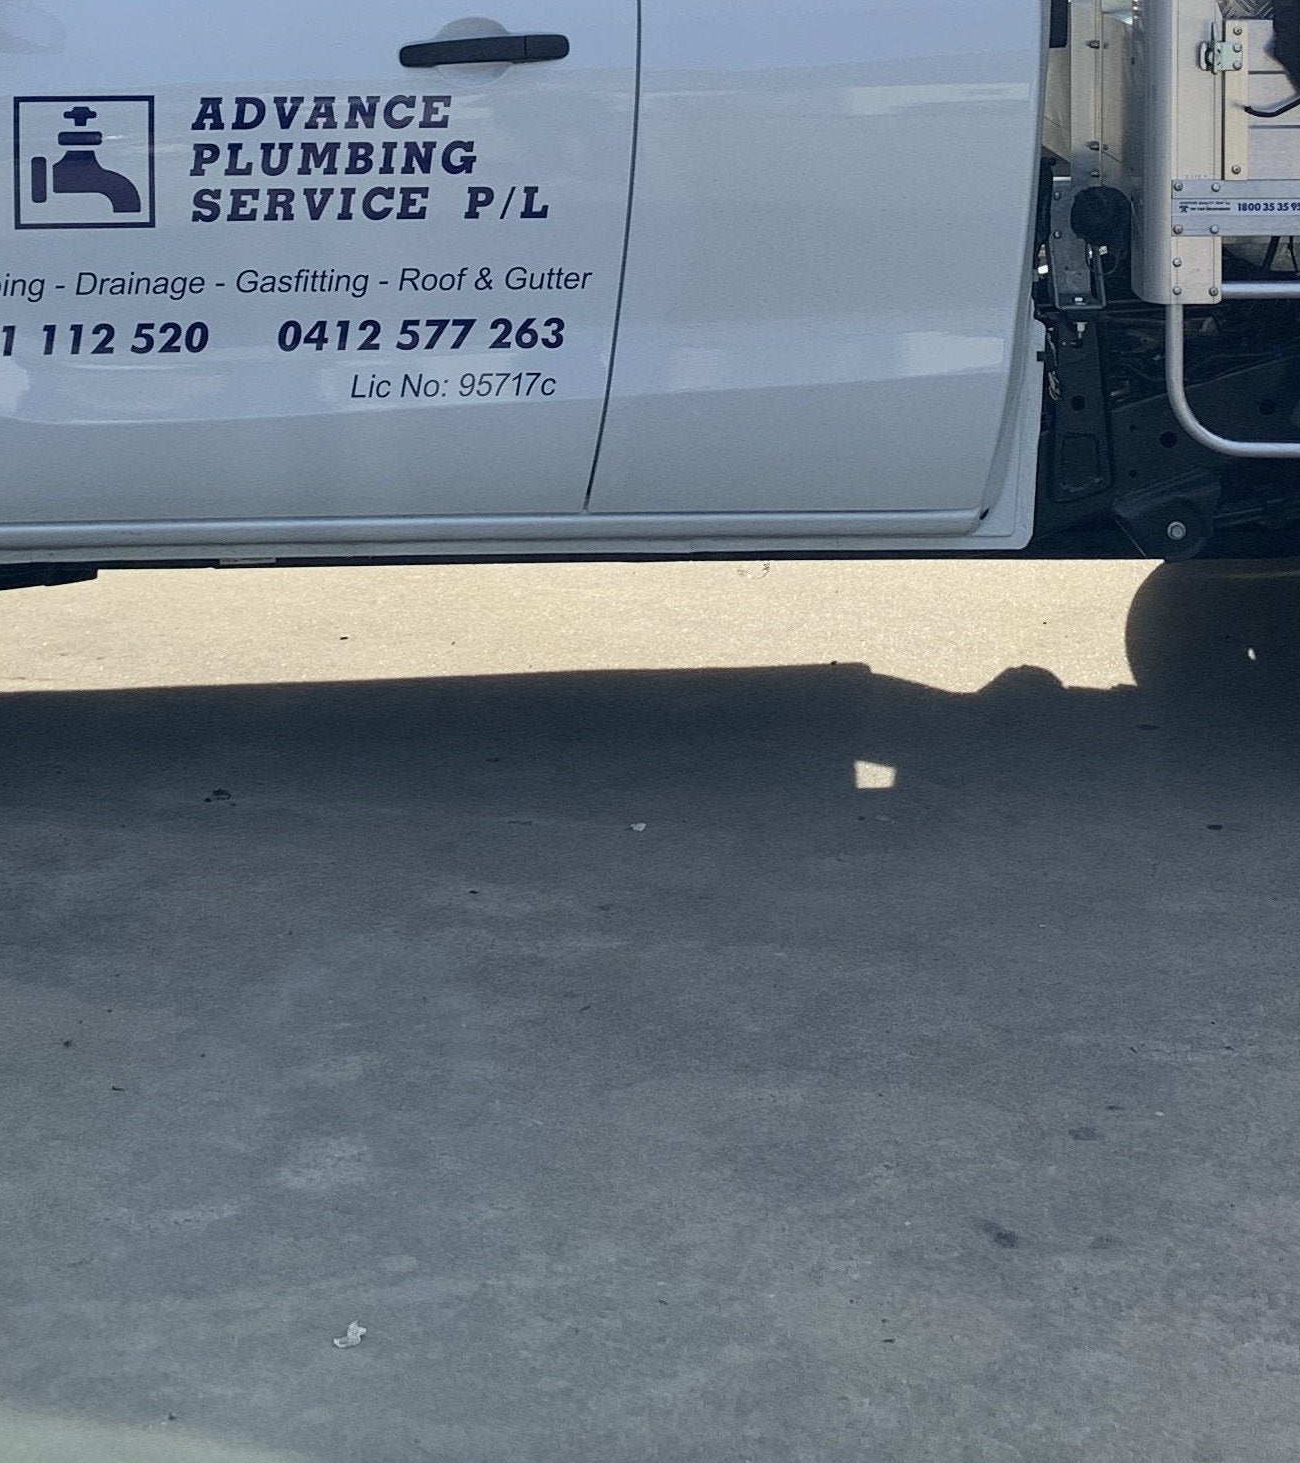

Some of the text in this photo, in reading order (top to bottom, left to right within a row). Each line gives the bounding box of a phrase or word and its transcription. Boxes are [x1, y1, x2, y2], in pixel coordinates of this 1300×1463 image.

[190, 95, 452, 131] ADVANCE
[189, 140, 477, 177] PLUMBING
[191, 185, 549, 223] SERVICE P/L
[1237, 202, 1261, 212] 1800
[75, 271, 206, 301] Drainage
[236, 268, 370, 298] Gasfitting
[398, 266, 469, 292] Roof
[474, 266, 494, 292] &
[504, 266, 593, 291] Gutter
[42, 323, 116, 355] 112
[130, 321, 210, 355] 520
[277, 317, 566, 352] 0412 577 263
[350, 372, 558, 398] Lic No: 95717c
